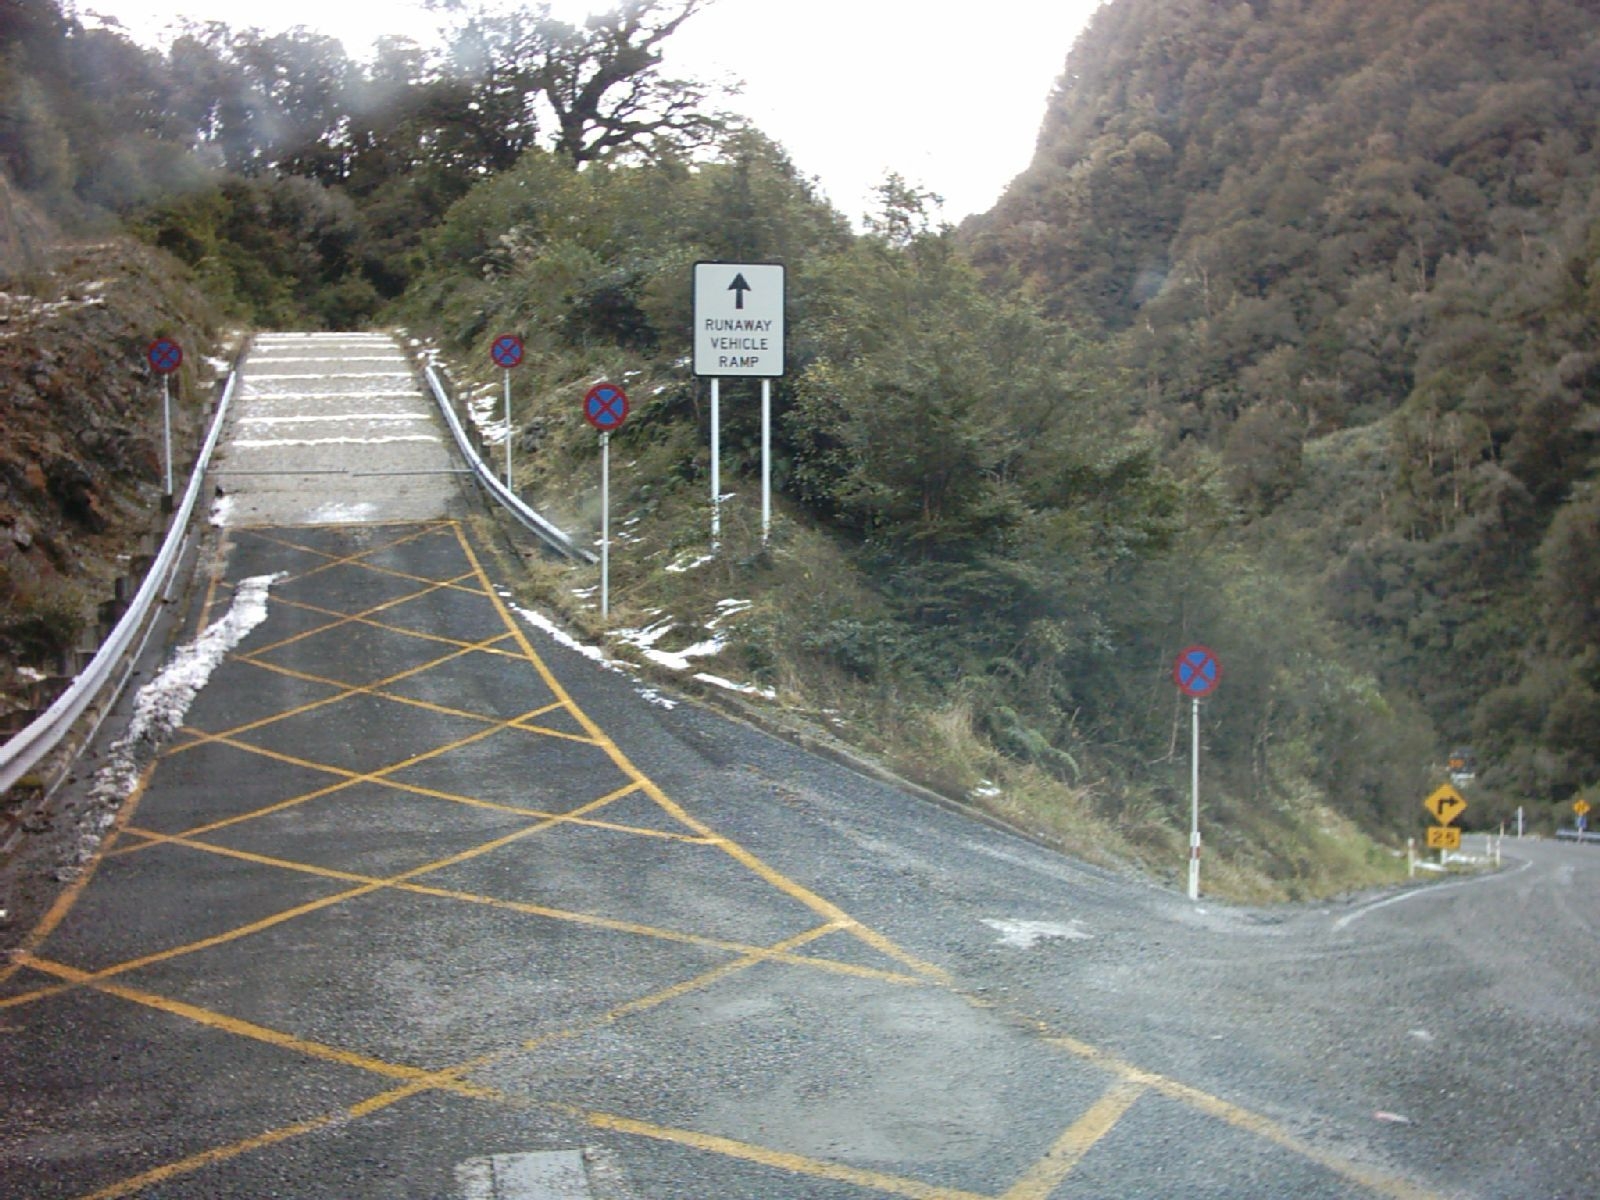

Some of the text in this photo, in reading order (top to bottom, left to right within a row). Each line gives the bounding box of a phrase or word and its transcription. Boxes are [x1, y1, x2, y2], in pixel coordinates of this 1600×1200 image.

[704, 318, 772, 331] RUNAWAY
[710, 337, 769, 350] VEHICLE
[718, 355, 759, 367] RAMP
[1432, 831, 1456, 845] 25
